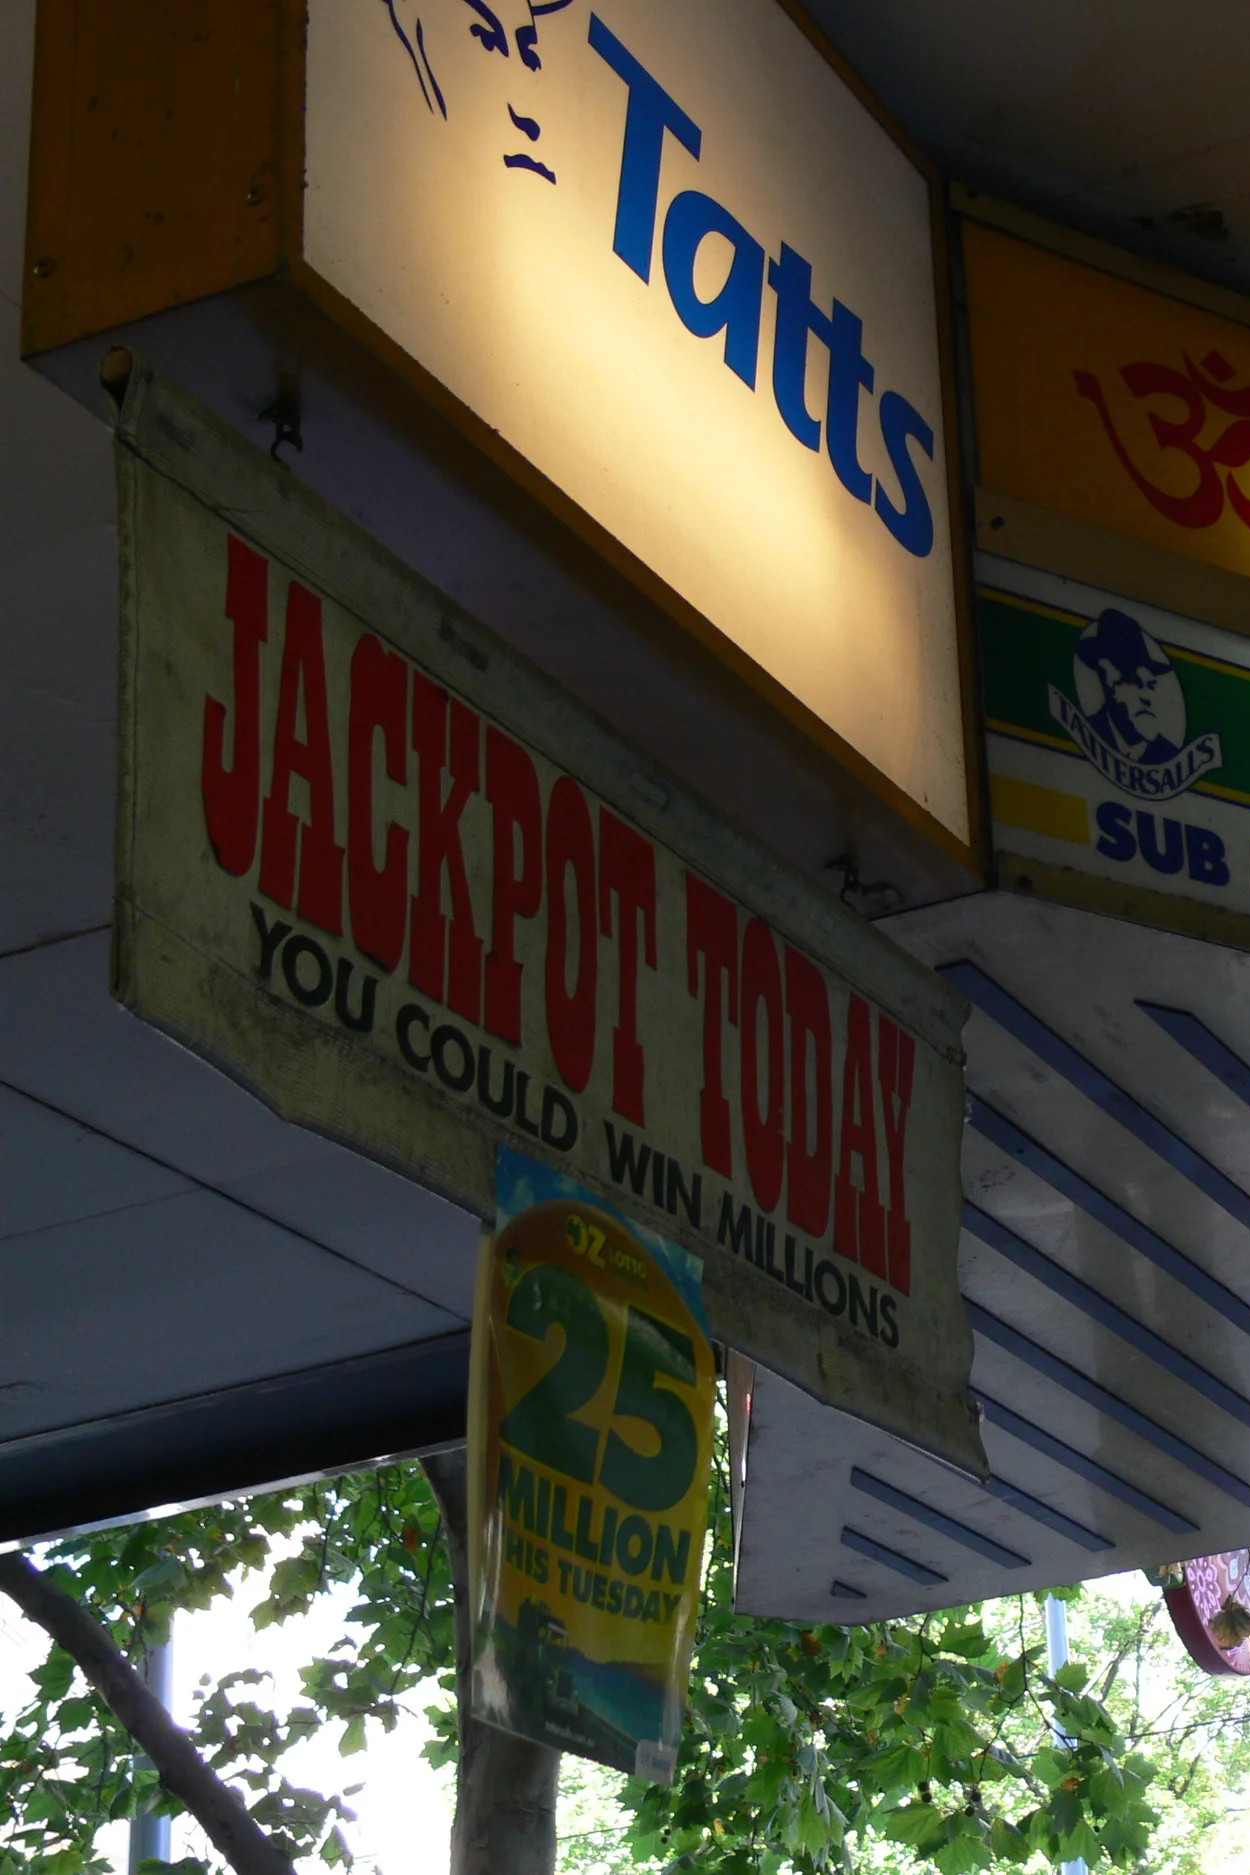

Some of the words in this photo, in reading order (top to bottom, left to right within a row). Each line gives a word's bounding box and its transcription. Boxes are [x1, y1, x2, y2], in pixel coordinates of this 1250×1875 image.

[588, 12, 934, 557] Tatts
[203, 533, 658, 1128] JACKPOT
[686, 871, 916, 1297] TODAY
[1096, 802, 1230, 887] SUB
[250, 900, 375, 1034] YOU
[395, 1002, 579, 1153] COULD
[604, 1120, 703, 1229] WIN
[717, 1190, 901, 1349] MILLIONS
[496, 1522, 549, 1584] HIS
[557, 1558, 683, 1624] TUESDAY
[499, 1454, 692, 1586] MILLION
